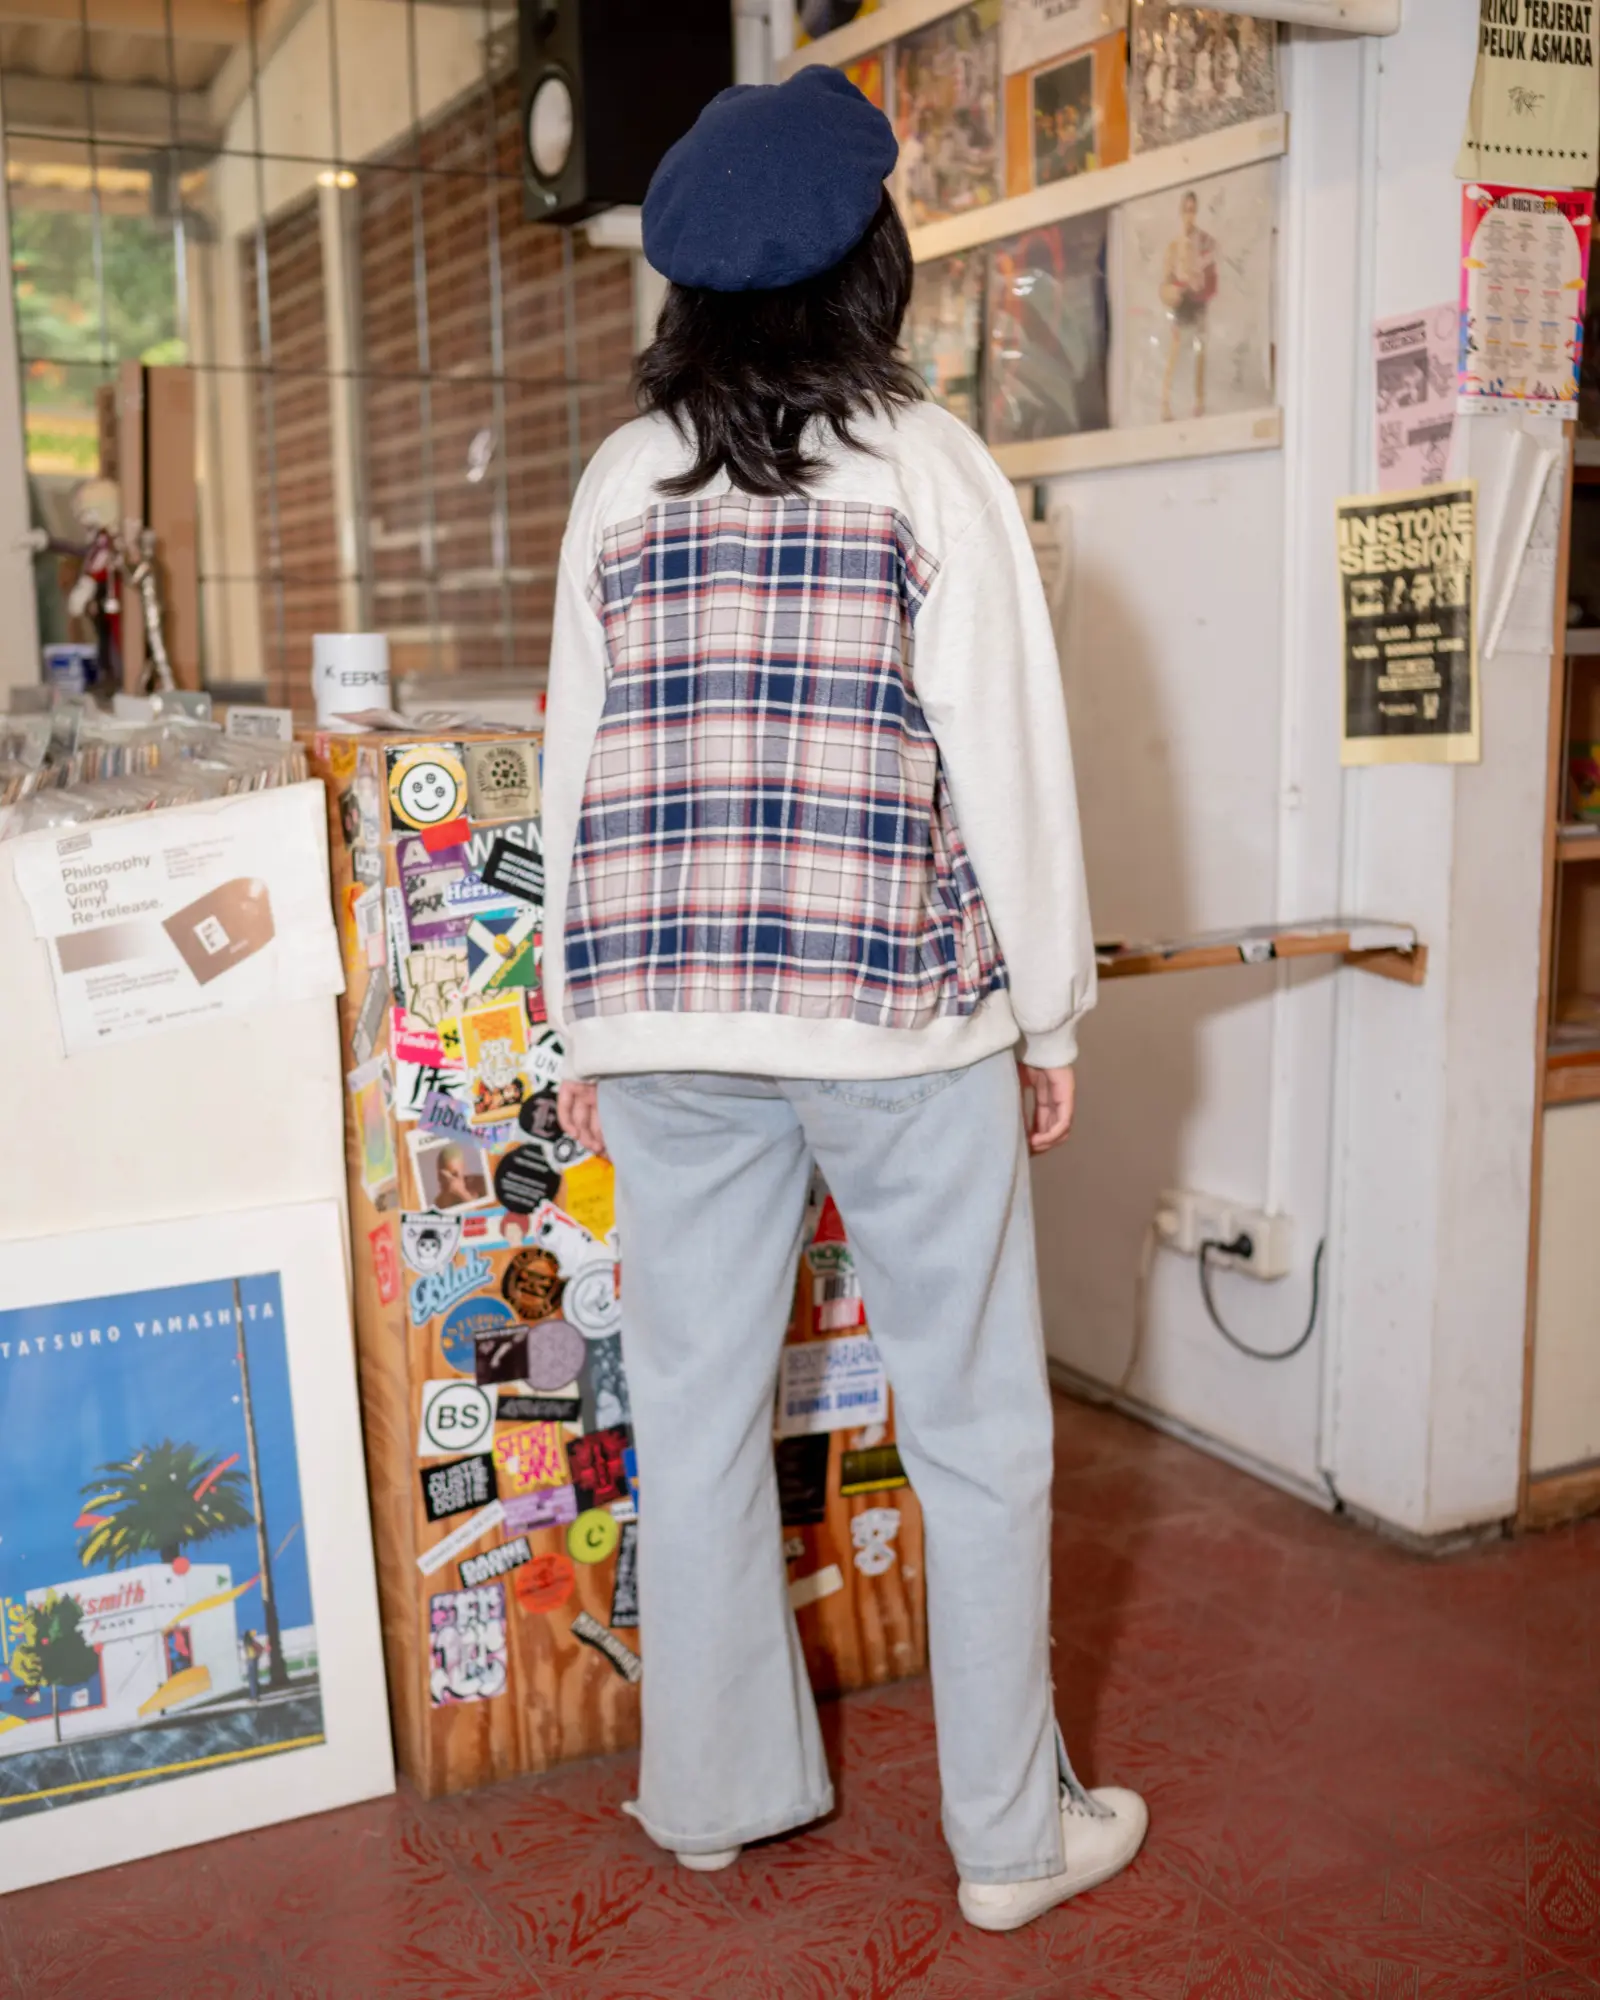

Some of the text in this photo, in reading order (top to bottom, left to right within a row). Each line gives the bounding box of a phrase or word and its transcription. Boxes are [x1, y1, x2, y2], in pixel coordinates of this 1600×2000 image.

[1525, 0, 1592, 34] TERJERAT
[1531, 32, 1593, 67] ASMARA
[1338, 502, 1472, 546] INSTORE
[1339, 532, 1471, 575] SESSION
[61, 854, 150, 882] Philosophy
[65, 879, 109, 896] Gang
[67, 890, 107, 910] Vinyl
[72, 898, 164, 926] Re-release.
[1, 1302, 275, 1359] TATSURO YAMASHITA
[437, 1404, 481, 1430] BS
